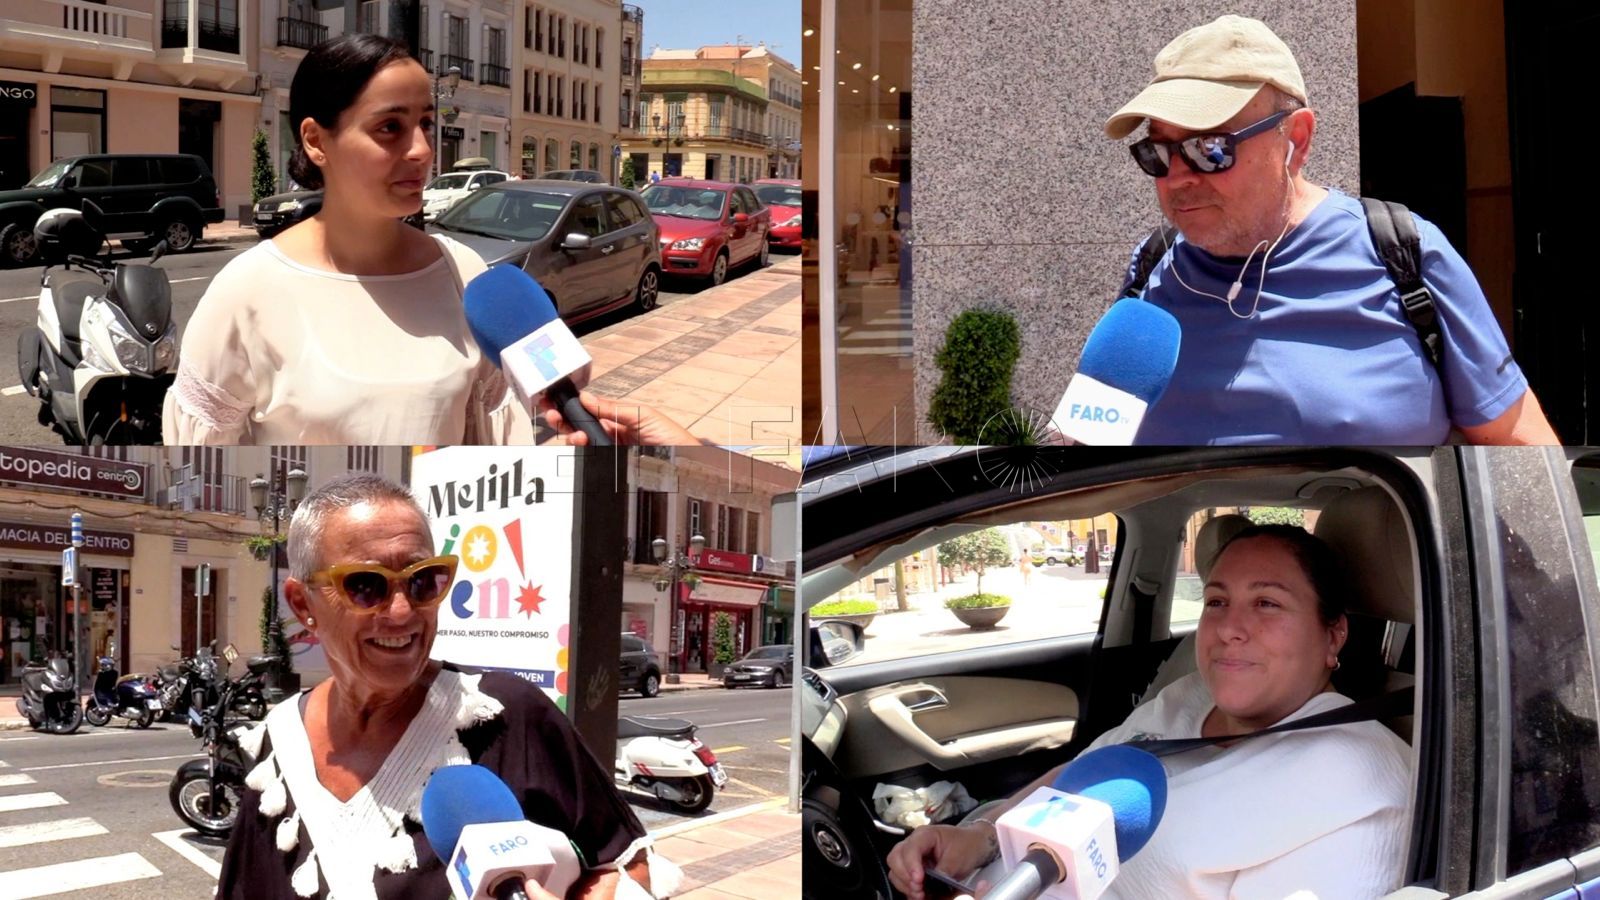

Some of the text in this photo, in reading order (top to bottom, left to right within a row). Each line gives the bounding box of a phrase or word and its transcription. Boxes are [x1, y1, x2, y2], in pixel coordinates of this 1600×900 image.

[0, 87, 35, 99] NGO
[1070, 403, 1120, 423] FARO
[427, 458, 546, 518] Melilla
[45, 531, 72, 545] DEL
[80, 534, 131, 550] ENTRO
[468, 630, 499, 638] NUESTRO
[500, 630, 550, 639] COMPROMISO
[489, 835, 528, 856] FARO
[1086, 838, 1107, 878] FARO
